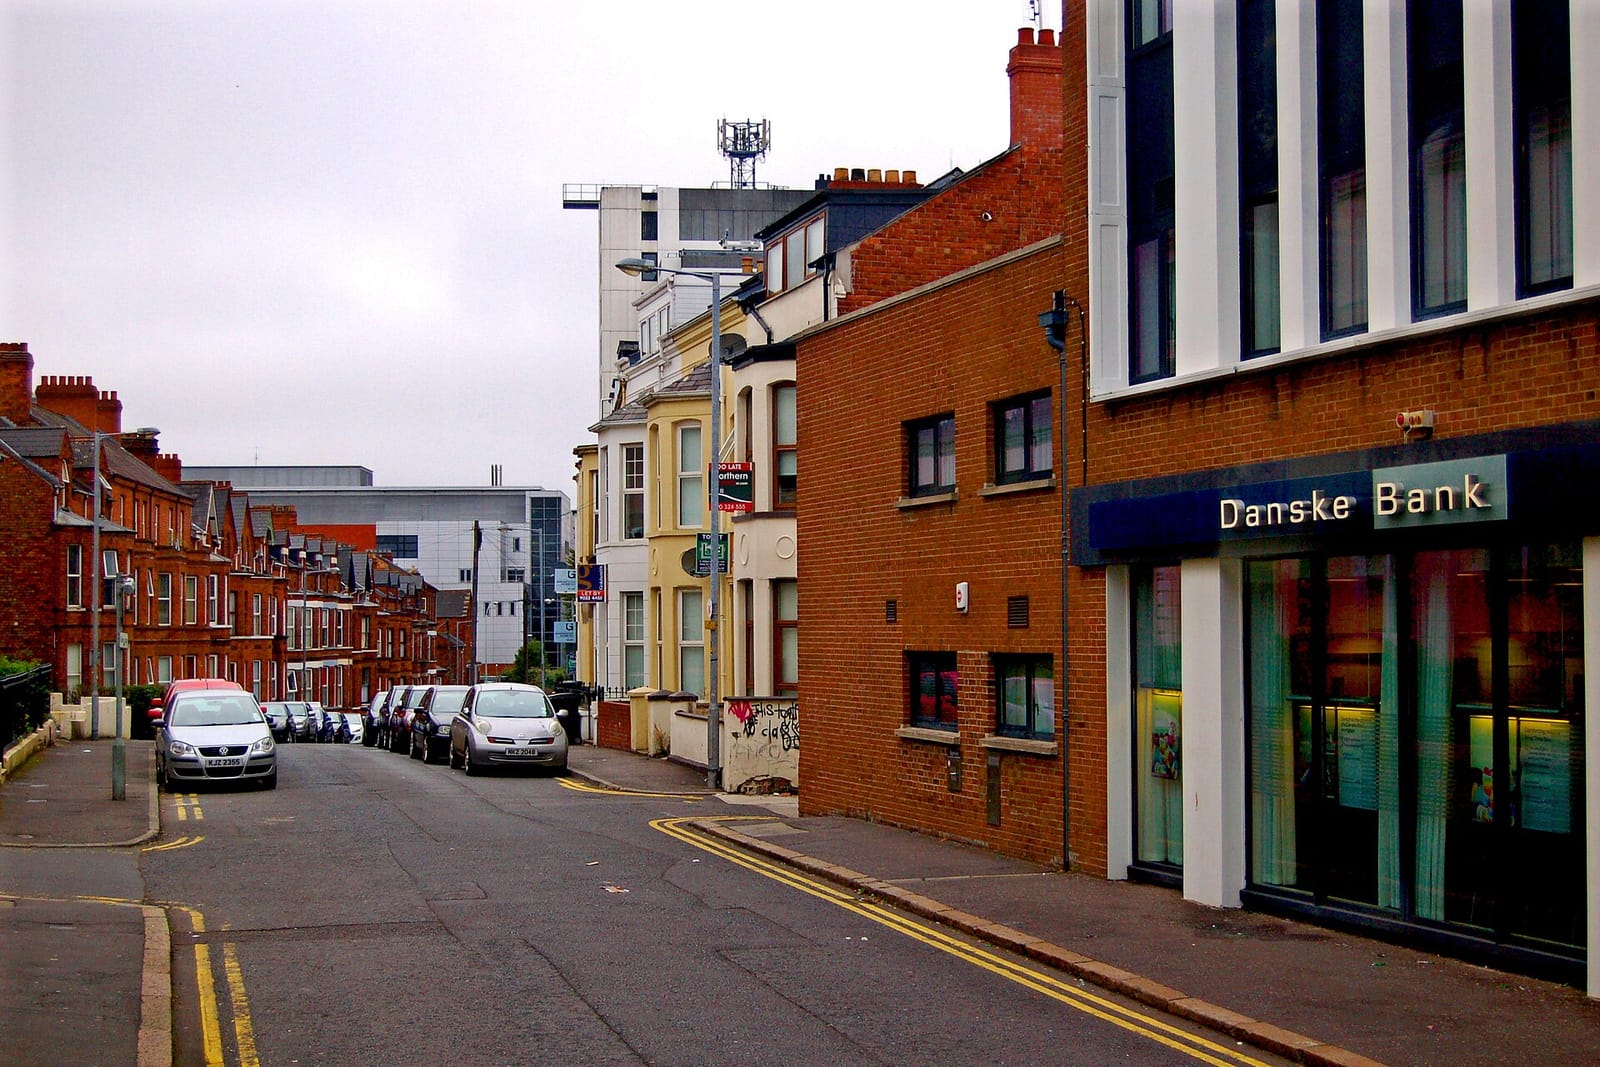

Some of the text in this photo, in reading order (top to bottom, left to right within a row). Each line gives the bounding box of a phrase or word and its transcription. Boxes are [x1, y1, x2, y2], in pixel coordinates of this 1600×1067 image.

[718, 471, 748, 480] orthern
[1220, 474, 1492, 529] Danske Bank
